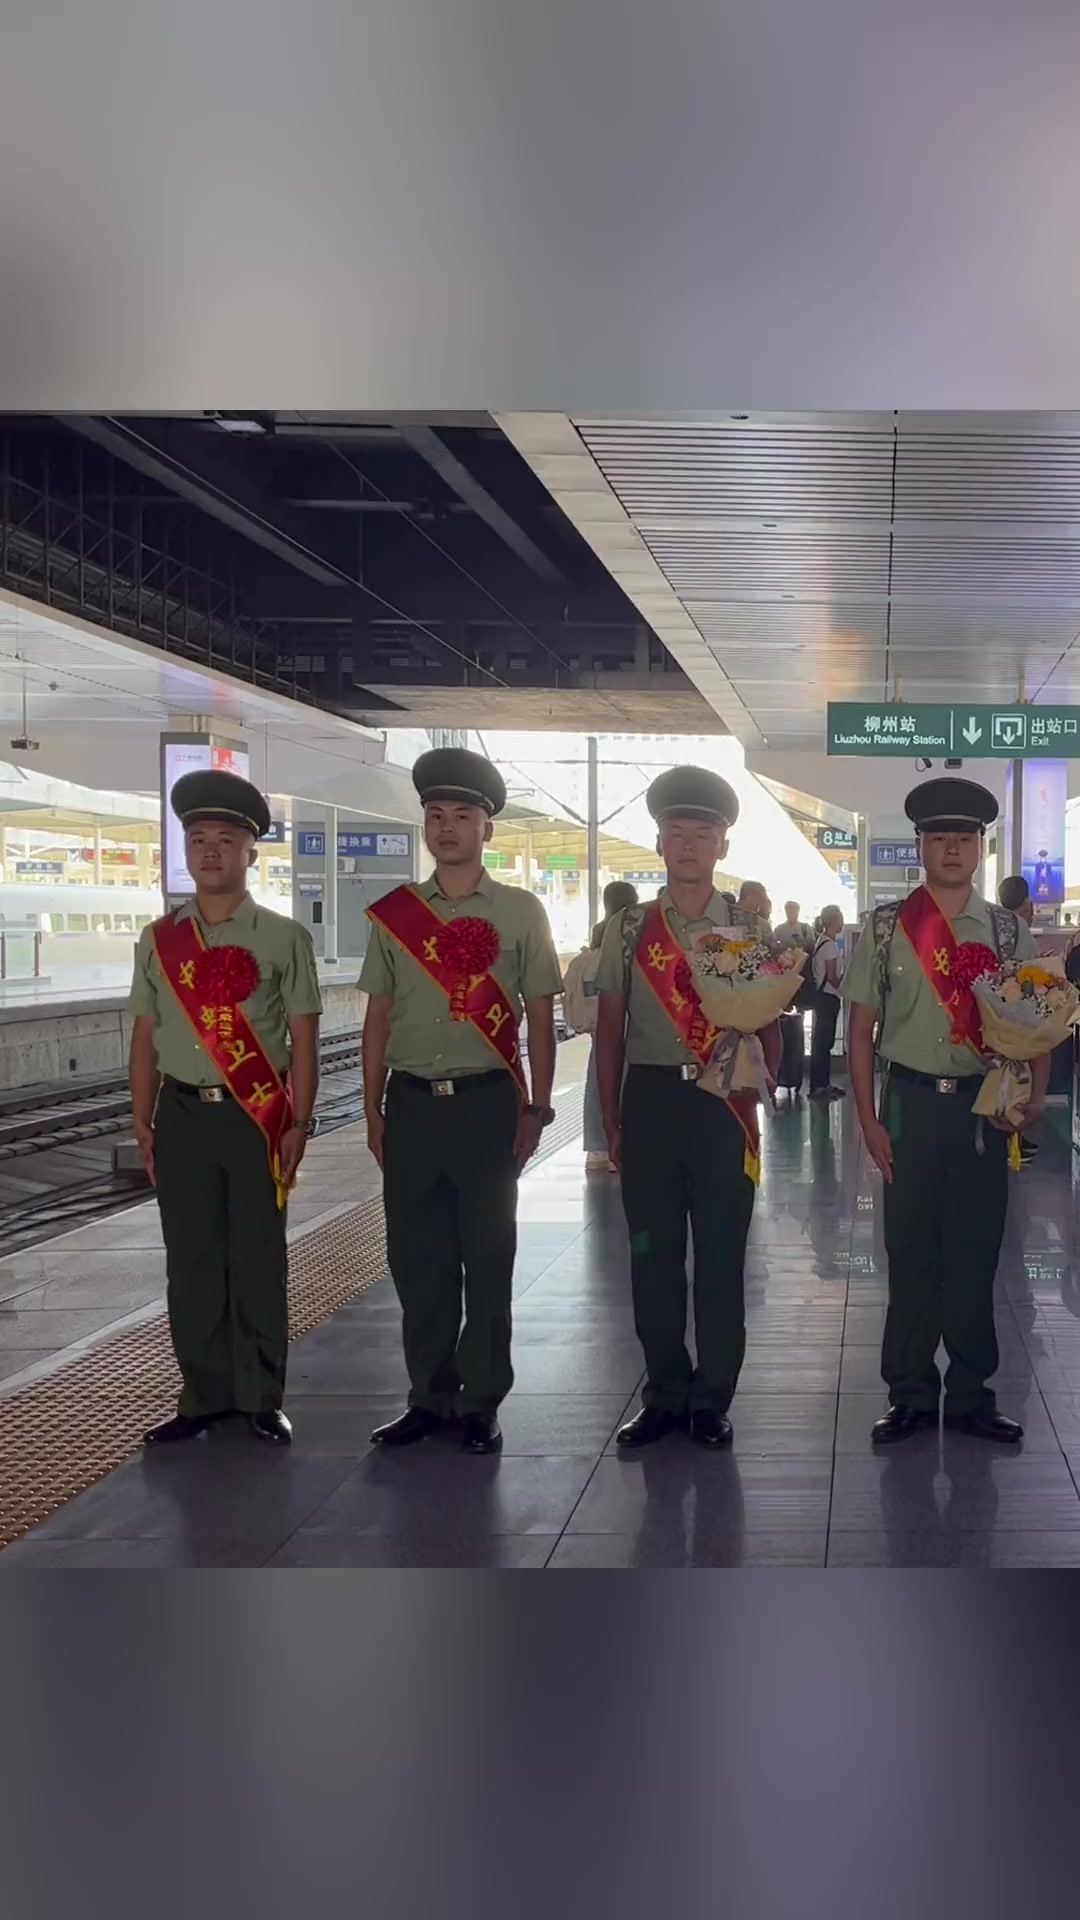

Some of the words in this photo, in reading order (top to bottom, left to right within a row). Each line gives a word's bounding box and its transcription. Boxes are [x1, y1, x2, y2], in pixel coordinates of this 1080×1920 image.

[864, 716, 916, 732] 柳州站
[1031, 718, 1077, 734] 出站口
[834, 734, 871, 744] Liuzhou
[874, 734, 911, 746] Railway
[912, 734, 946, 745] Station
[1031, 736, 1050, 746] Exit
[823, 831, 833, 845] 8
